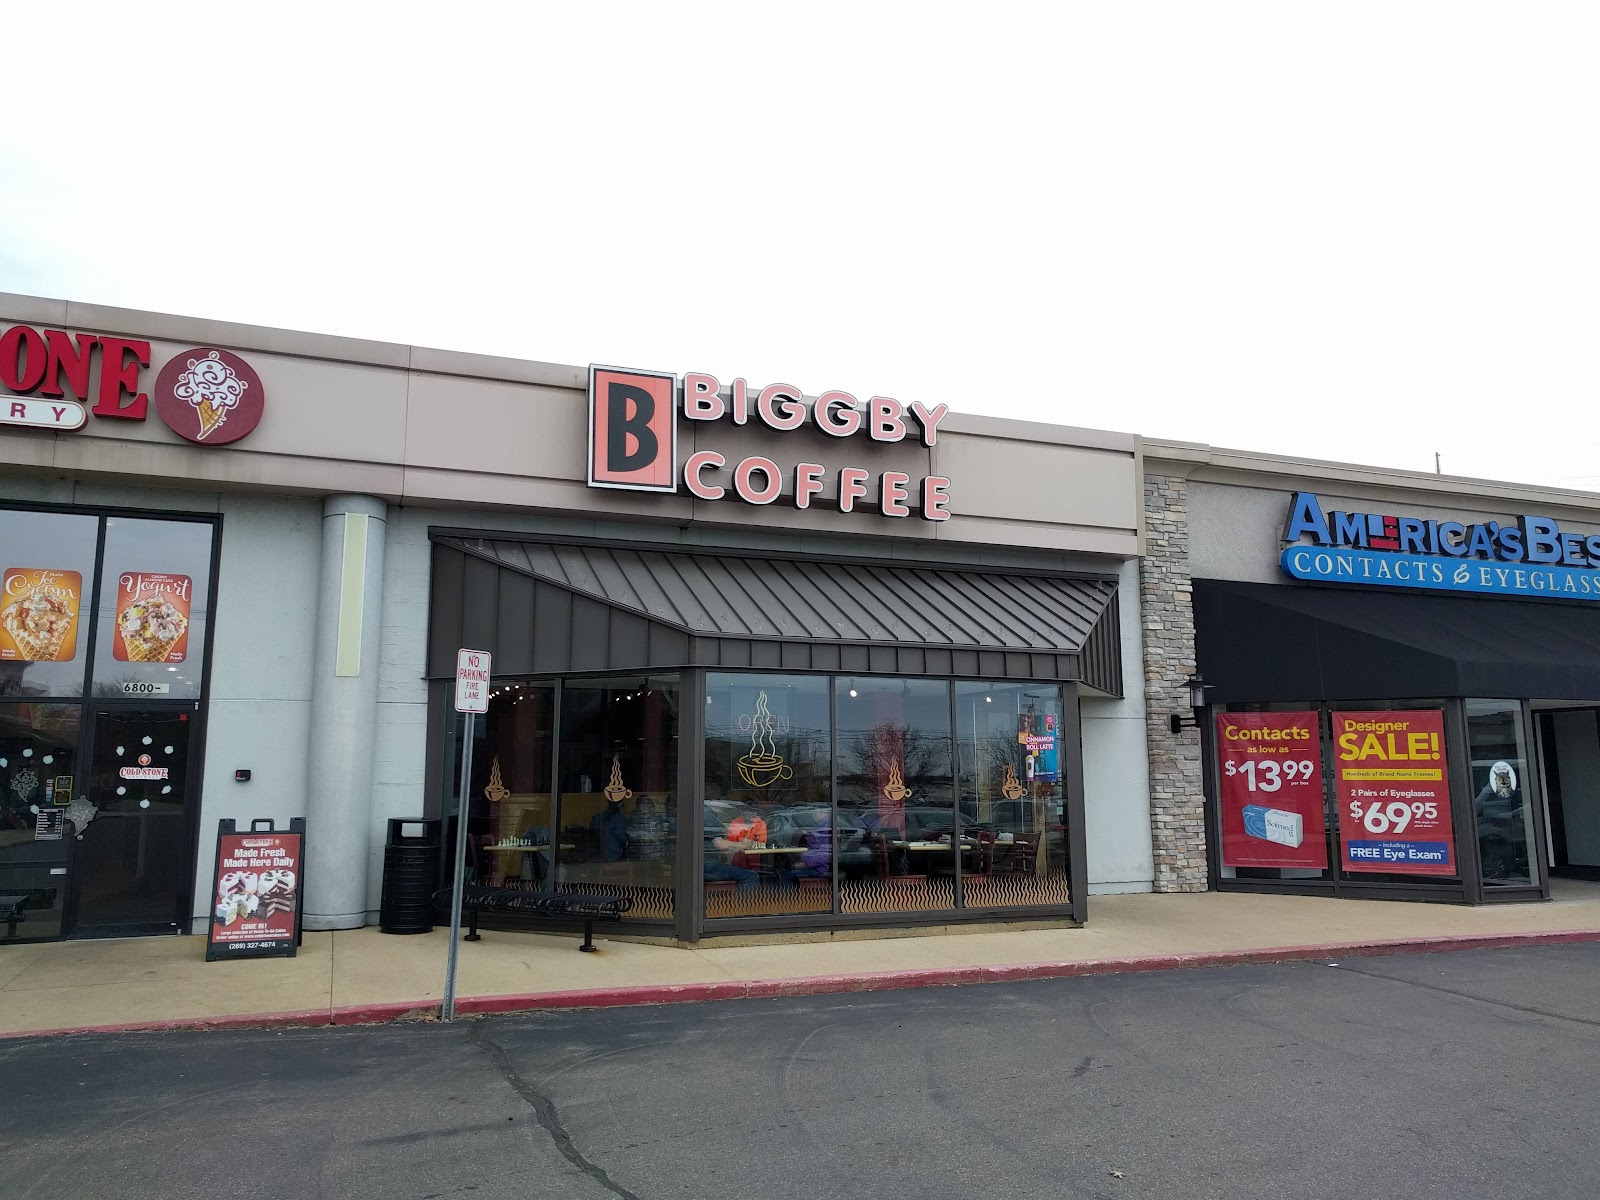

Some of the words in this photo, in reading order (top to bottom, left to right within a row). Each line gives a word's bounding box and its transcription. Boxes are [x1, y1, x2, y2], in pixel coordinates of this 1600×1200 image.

[684, 371, 949, 448] BIGGBY
[607, 382, 659, 473] B
[683, 450, 951, 521] COFFEE
[1293, 551, 1444, 583] CONTACTS
[31, 571, 58, 586] Ice
[5, 575, 77, 600] Cream
[120, 574, 190, 601] Yogurt
[468, 656, 479, 667] NO
[460, 668, 488, 681] PARKING
[466, 681, 479, 690] FIRE
[464, 691, 480, 699] LANE
[1225, 725, 1310, 741] Contacts
[1345, 719, 1410, 735] Designer
[1025, 735, 1055, 743] CINNAMON
[1259, 744, 1277, 753] low
[1339, 732, 1440, 761] SALE!
[120, 767, 141, 777] COLD
[141, 767, 168, 778] STONE
[1358, 789, 1378, 797] Pairs
[1379, 789, 1389, 797] of
[1390, 789, 1435, 799] Eyeglasses
[235, 849, 258, 857] Made
[261, 848, 285, 857] Fresh
[1350, 847, 1381, 858] FREE
[1383, 848, 1405, 861] Eye
[224, 859, 248, 867] Made
[250, 858, 271, 867] Here
[274, 858, 294, 867] Daily
